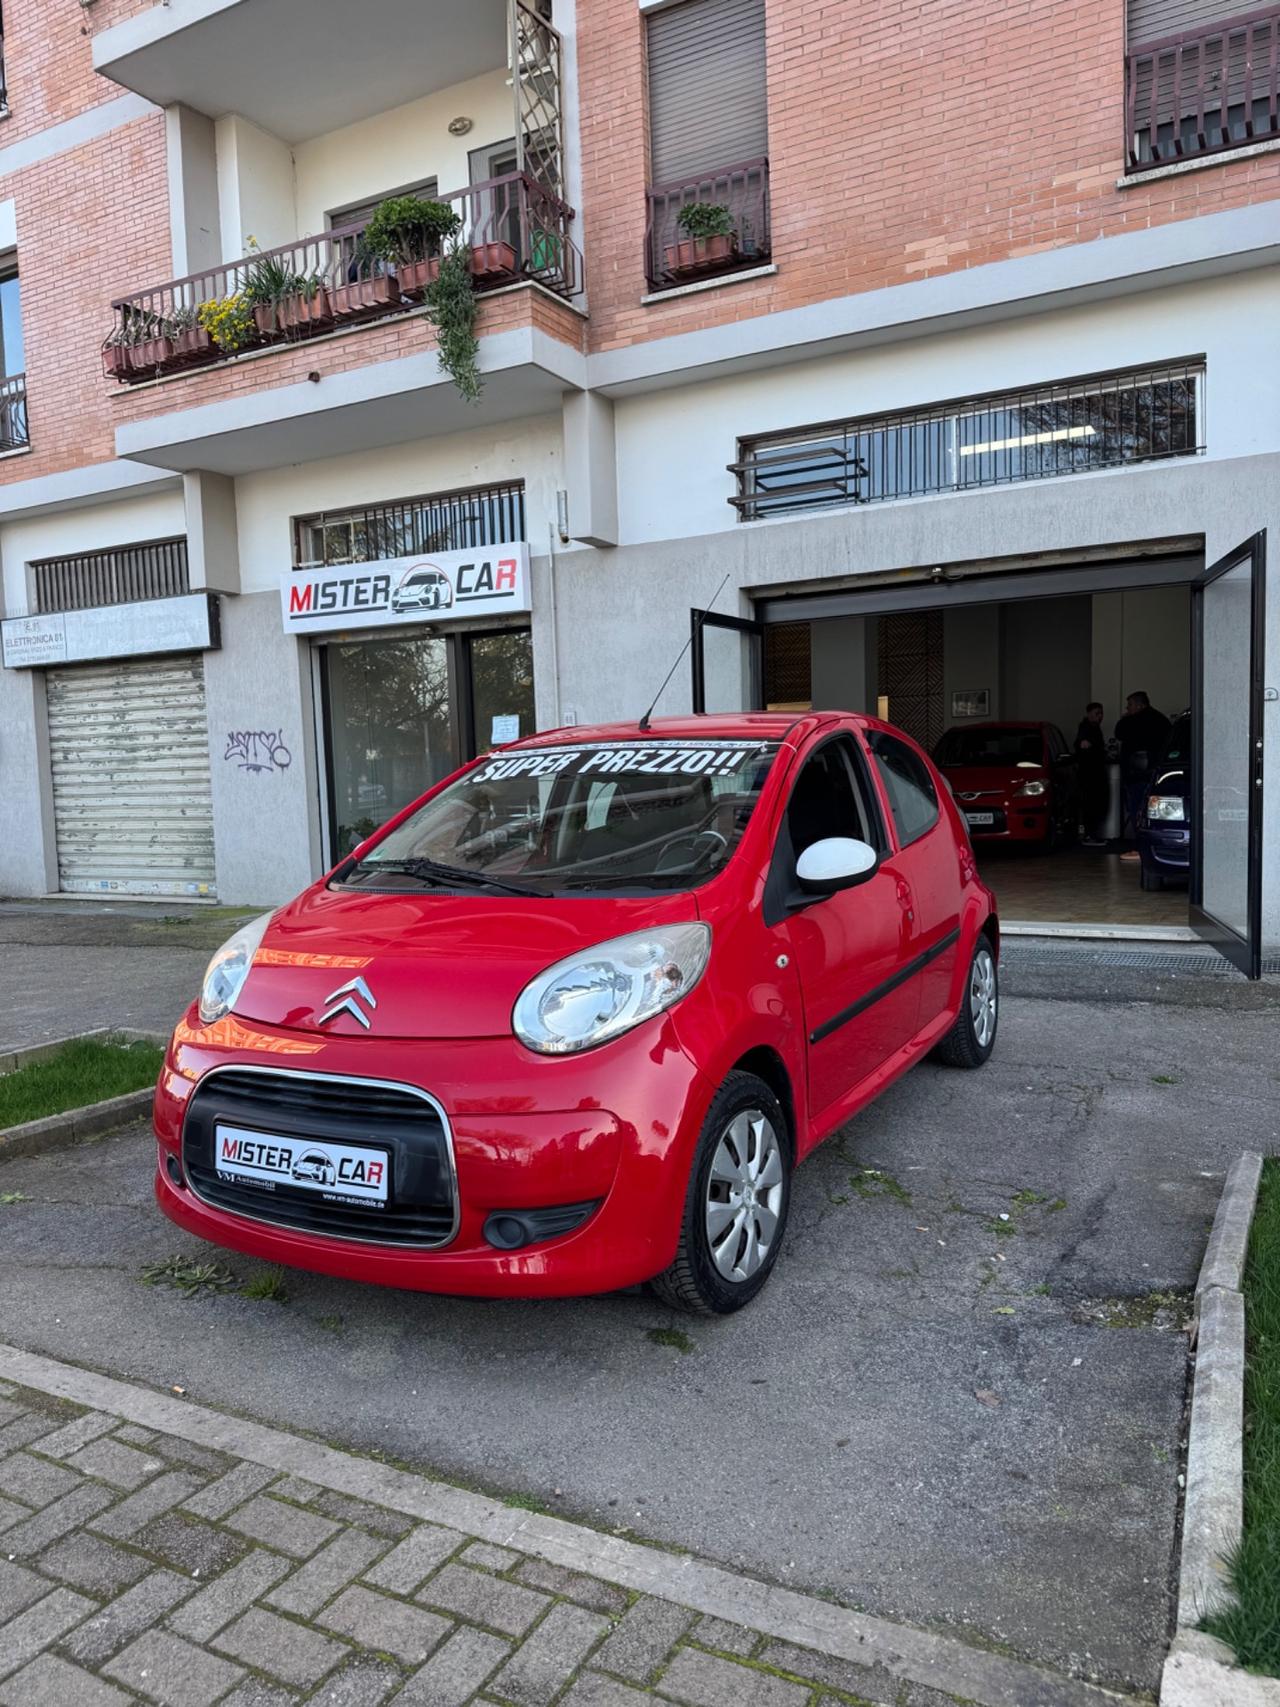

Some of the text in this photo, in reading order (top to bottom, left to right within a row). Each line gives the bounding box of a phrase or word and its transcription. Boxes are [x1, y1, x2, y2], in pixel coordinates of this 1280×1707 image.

[289, 559, 517, 613] MISTER CAR
[5, 634, 54, 648] ELETTRONICA
[577, 750, 746, 776] PREZZO!!
[222, 1138, 383, 1184] MISTER CAR
[217, 1170, 235, 1183] VM
